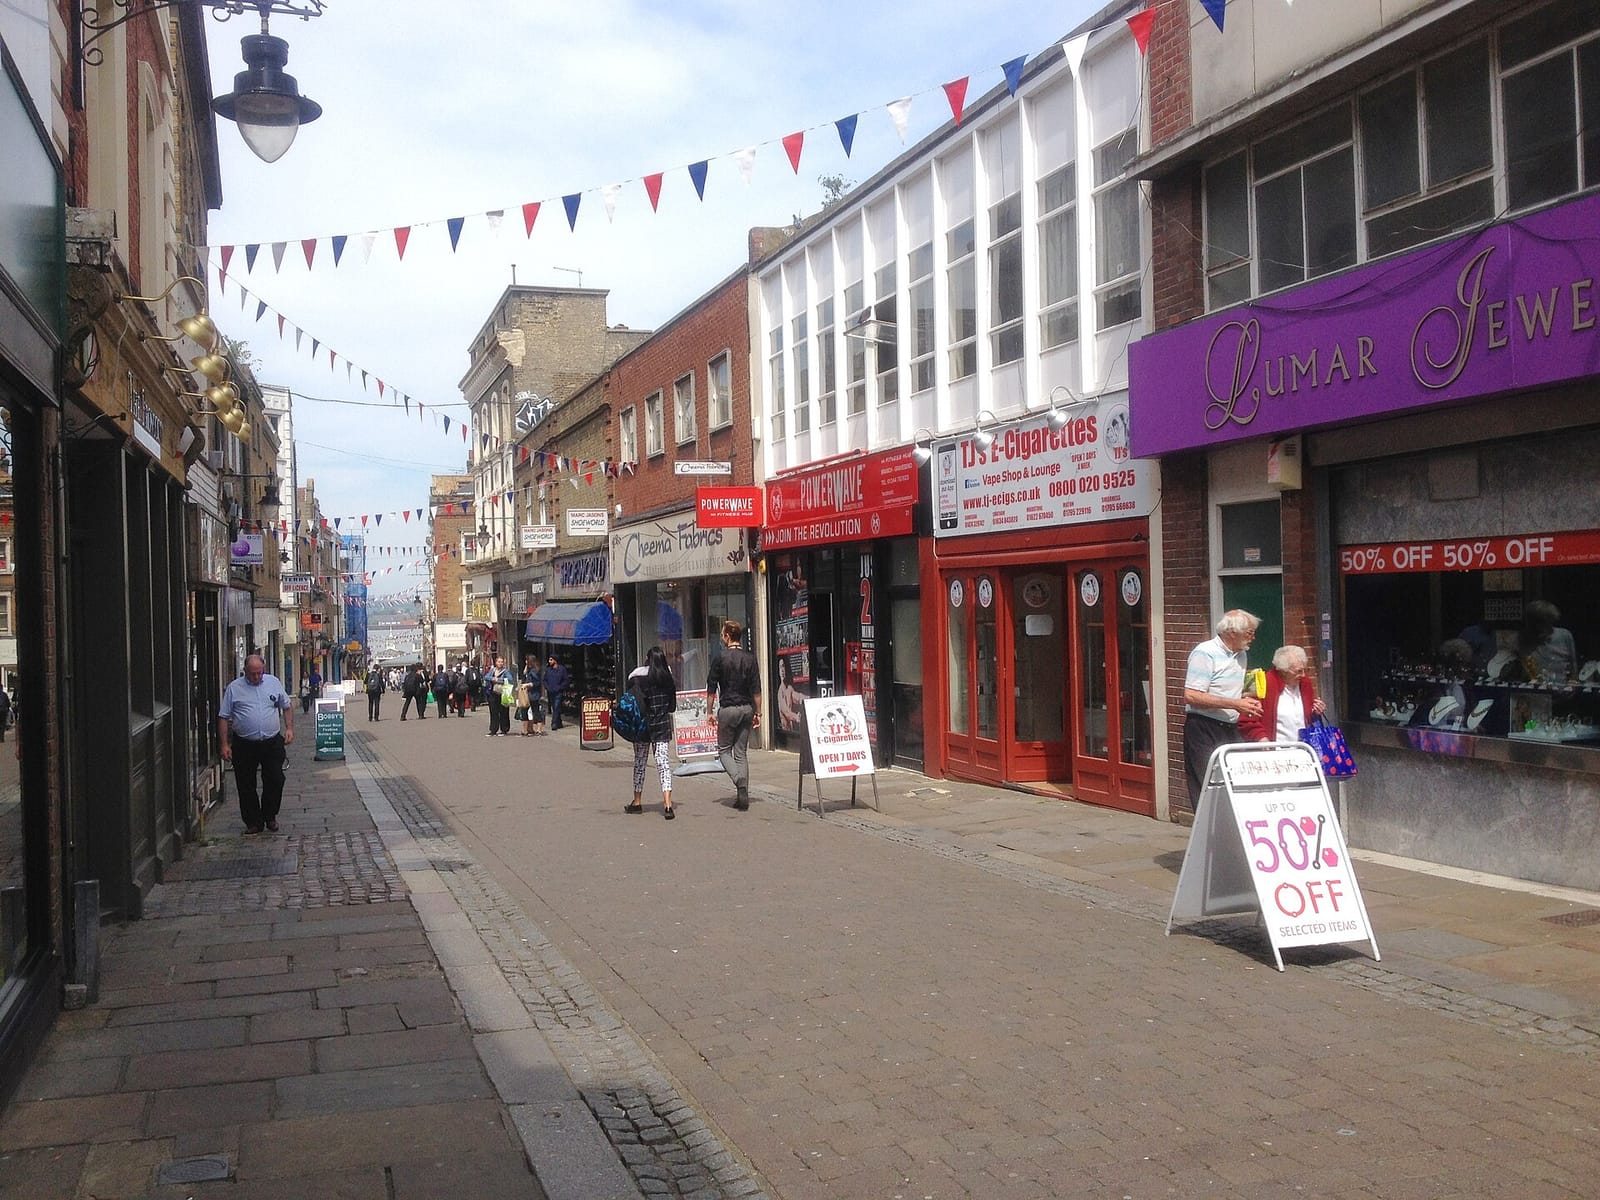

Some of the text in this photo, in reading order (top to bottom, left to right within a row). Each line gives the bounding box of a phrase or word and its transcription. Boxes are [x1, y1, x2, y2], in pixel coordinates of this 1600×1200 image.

[1071, 453, 1082, 463] OPEN
[1086, 450, 1097, 461] DAYS
[1113, 446, 1128, 460] TJ's
[982, 473, 1001, 487] Vape
[1002, 468, 1022, 482] Shop
[1023, 466, 1029, 478] &
[1030, 463, 1061, 478] Lounge
[1049, 468, 1136, 498] 0800 020 9525
[800, 464, 864, 513] POWERWAVE
[701, 498, 753, 512] POWERWAVE
[963, 486, 1041, 510] www.tj-ecigs.co.uk
[570, 519, 605, 527] SHOEWORLD
[775, 518, 862, 544] JOIN THE REVOLUTION
[624, 520, 723, 577] Cheema Fabrics
[1341, 547, 1385, 572] 50%
[1392, 545, 1433, 569] OFF
[1444, 540, 1497, 567] 50%
[1505, 537, 1554, 564] OFF
[860, 577, 872, 624] 2
[583, 702, 609, 712] BLINDS
[677, 728, 717, 740] POWERWAVE
[817, 733, 863, 744] E-Cigarettes
[829, 724, 850, 735] TJ's
[819, 750, 866, 763] OPEN 7 DAYS
[1265, 802, 1296, 813] UP TO
[1245, 814, 1339, 873] 50%
[1274, 880, 1344, 918] OFF
[1279, 920, 1358, 938] SELECTED ITEMS
